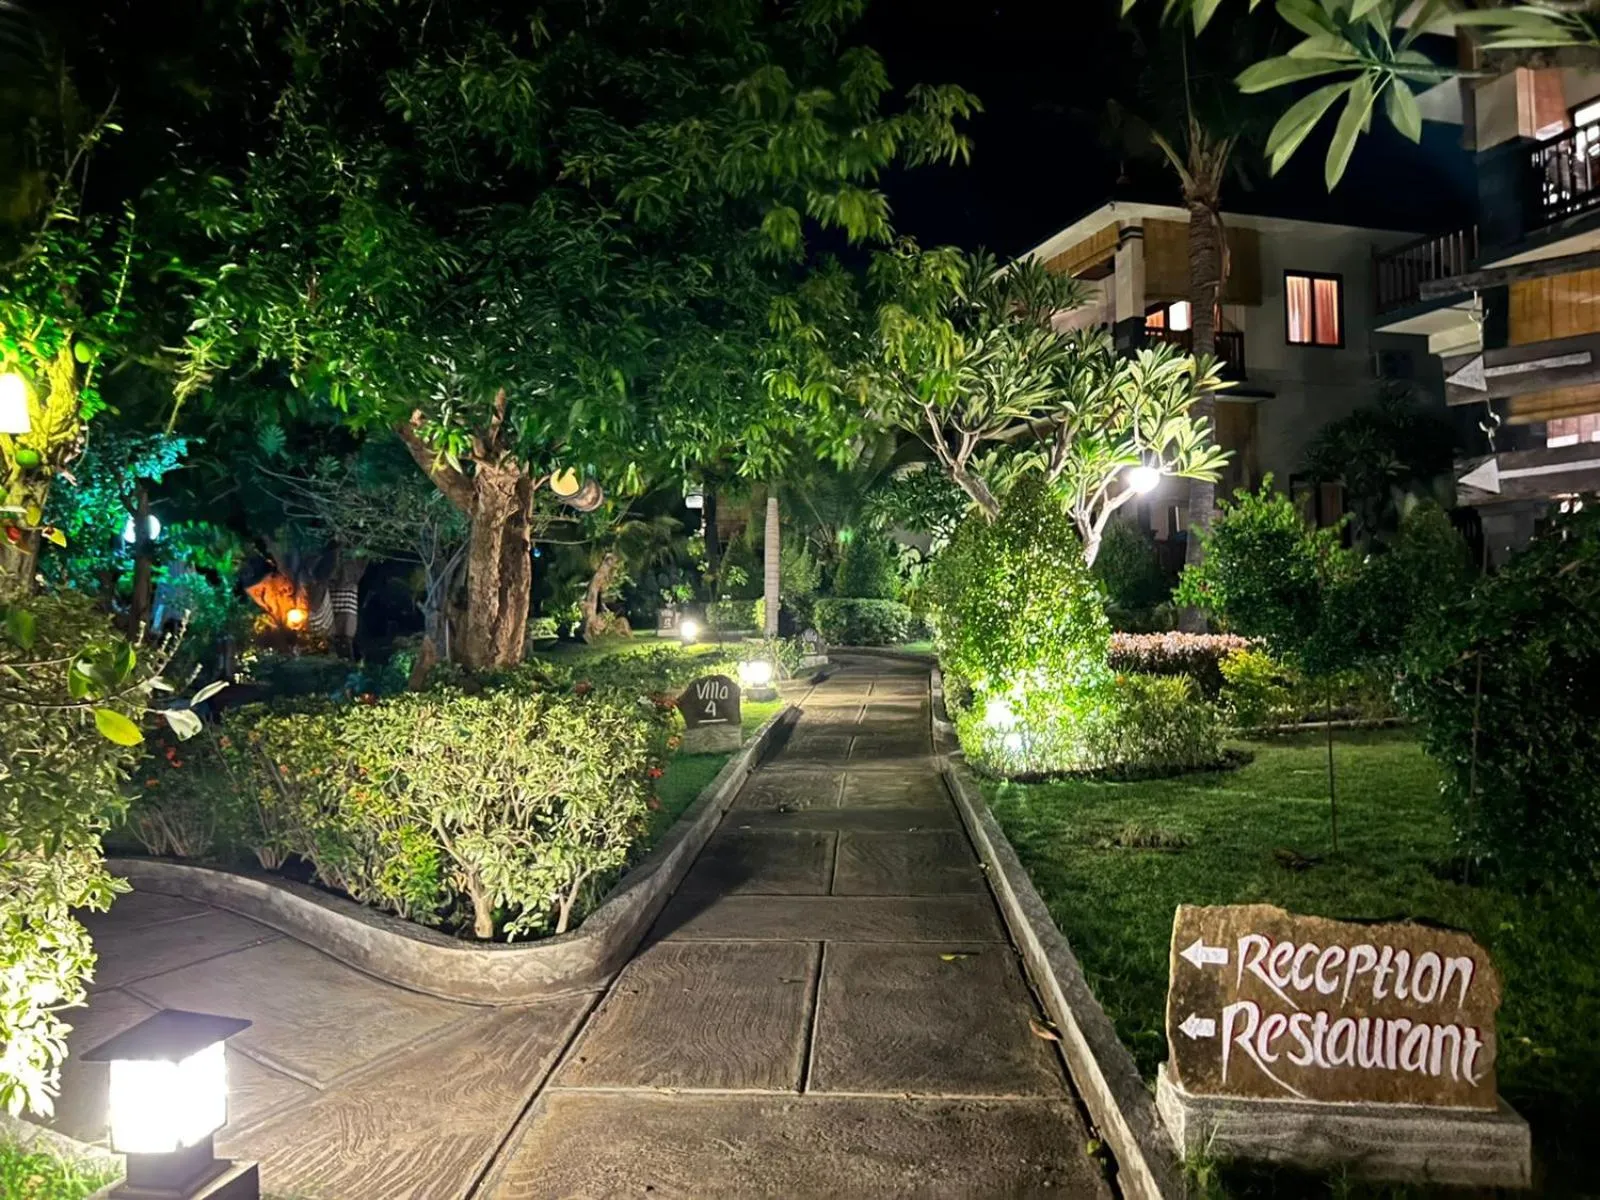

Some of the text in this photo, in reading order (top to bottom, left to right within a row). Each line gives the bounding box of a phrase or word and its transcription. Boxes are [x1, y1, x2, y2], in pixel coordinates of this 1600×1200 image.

[696, 681, 729, 700] Villa
[704, 700, 717, 717] 4
[1236, 934, 1475, 1010] Reception
[1222, 1001, 1483, 1098] Restaurant
